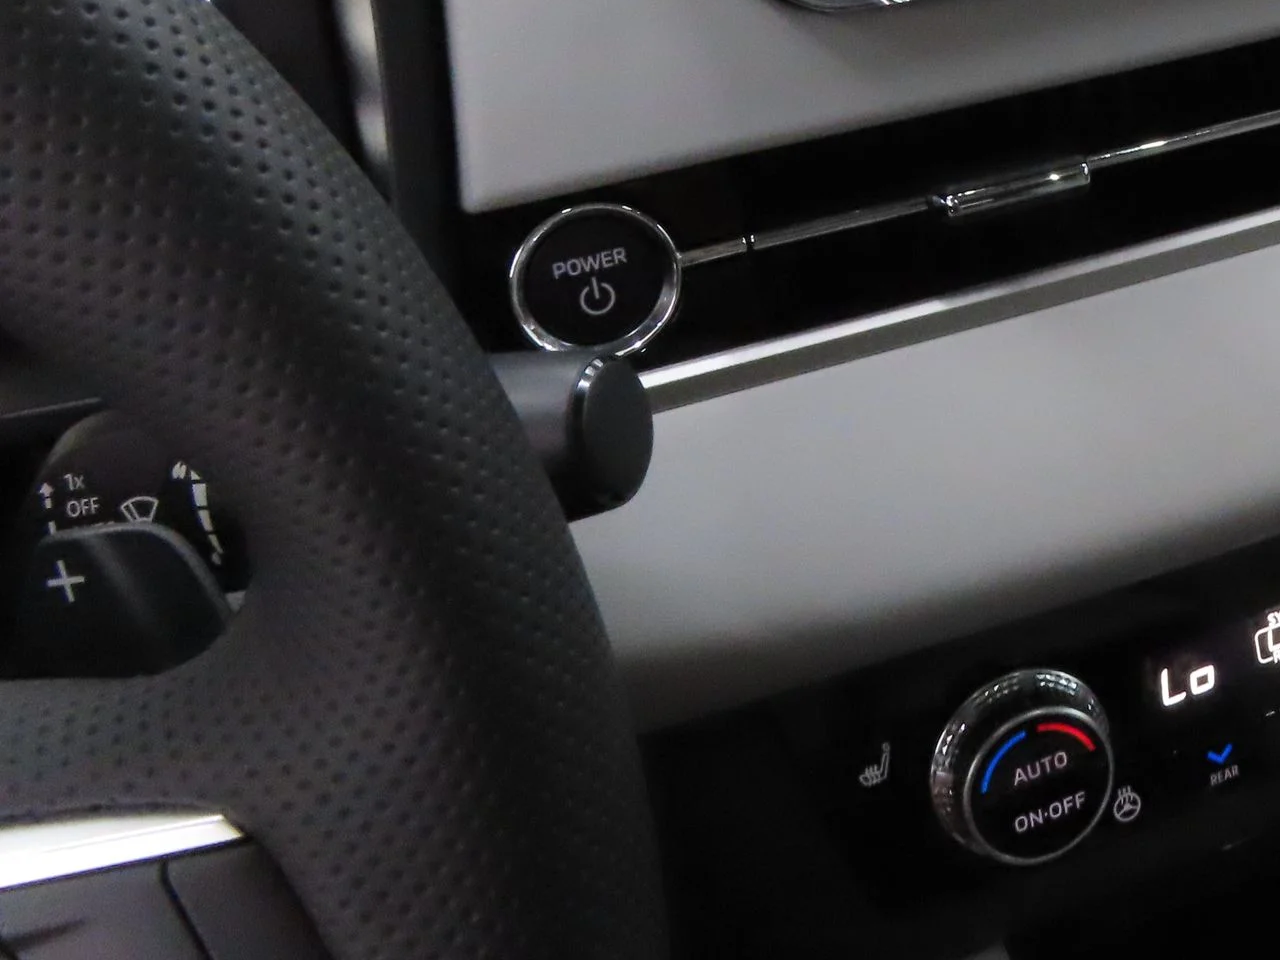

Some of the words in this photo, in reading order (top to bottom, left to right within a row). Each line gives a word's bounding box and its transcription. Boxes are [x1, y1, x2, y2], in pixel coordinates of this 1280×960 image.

[552, 247, 628, 280] POWER
[63, 473, 85, 491] 1x
[66, 497, 101, 518] OFF
[1160, 664, 1216, 707] Lo
[1013, 750, 1069, 787] AUTO
[1210, 764, 1240, 787] REAR
